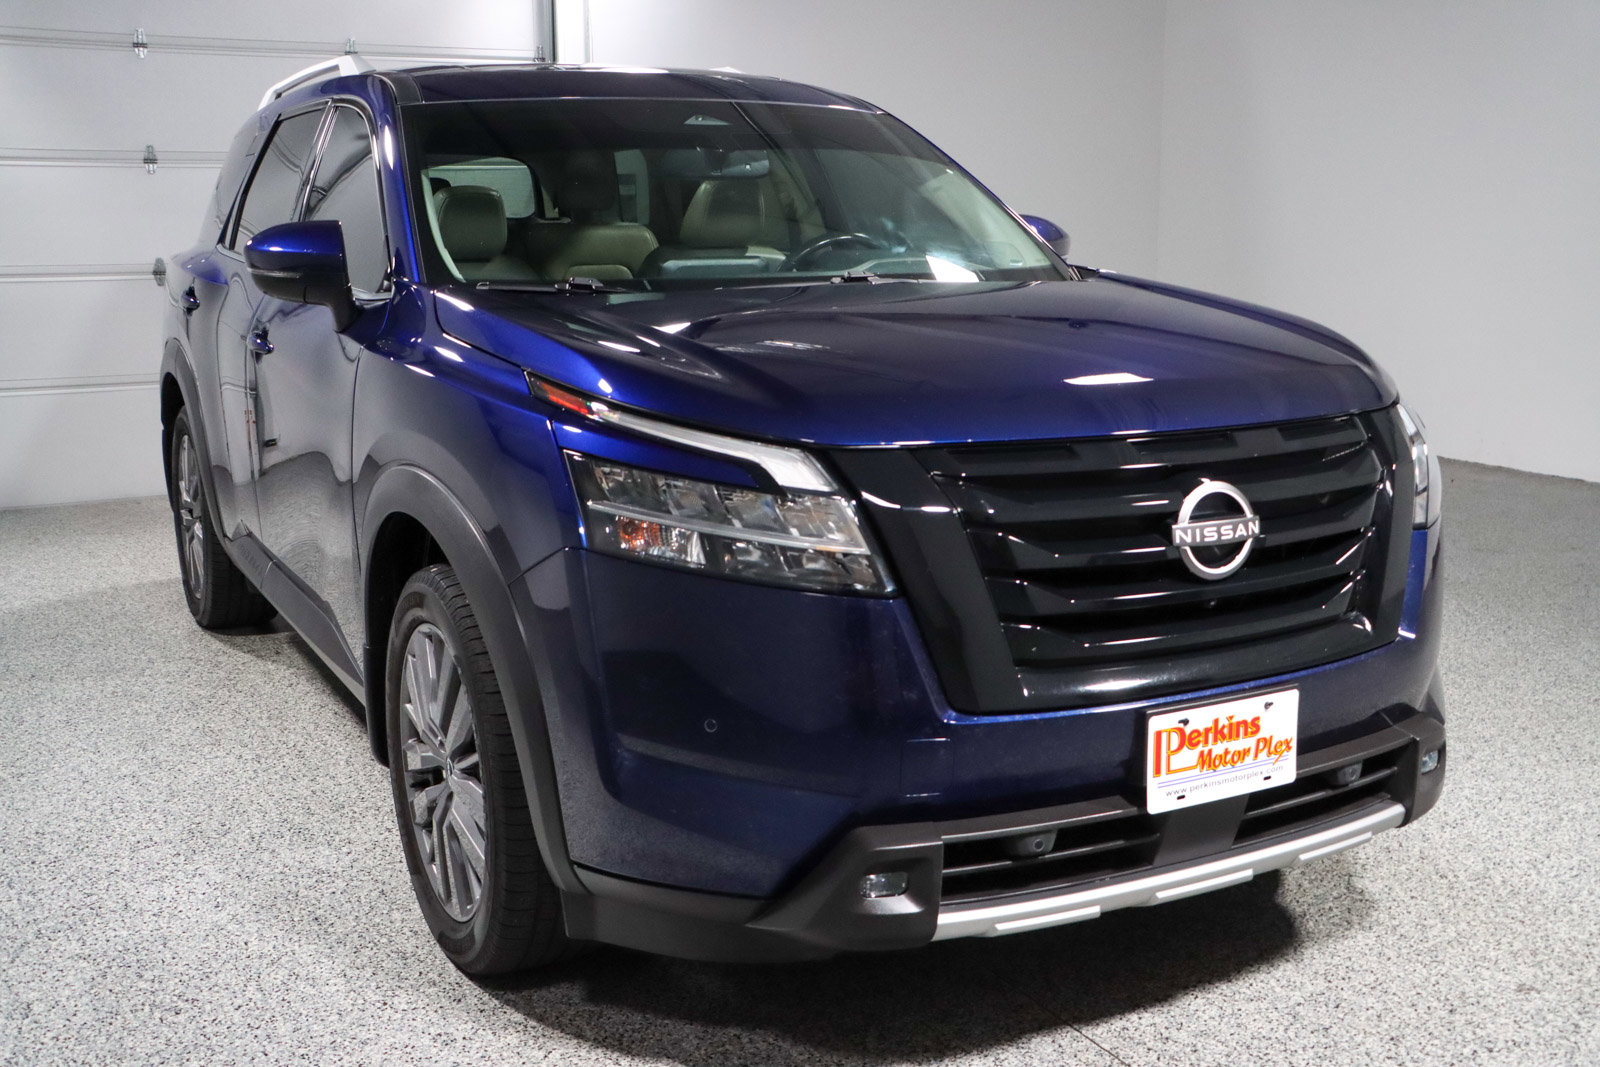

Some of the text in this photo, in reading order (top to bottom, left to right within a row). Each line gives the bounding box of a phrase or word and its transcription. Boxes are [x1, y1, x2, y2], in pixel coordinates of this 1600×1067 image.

[1175, 520, 1259, 543] NISSAN
[1153, 715, 1261, 777] Perkins
[1196, 735, 1293, 772] Motor Plex
[1166, 765, 1283, 797] www.perkinsmotorplex.com
